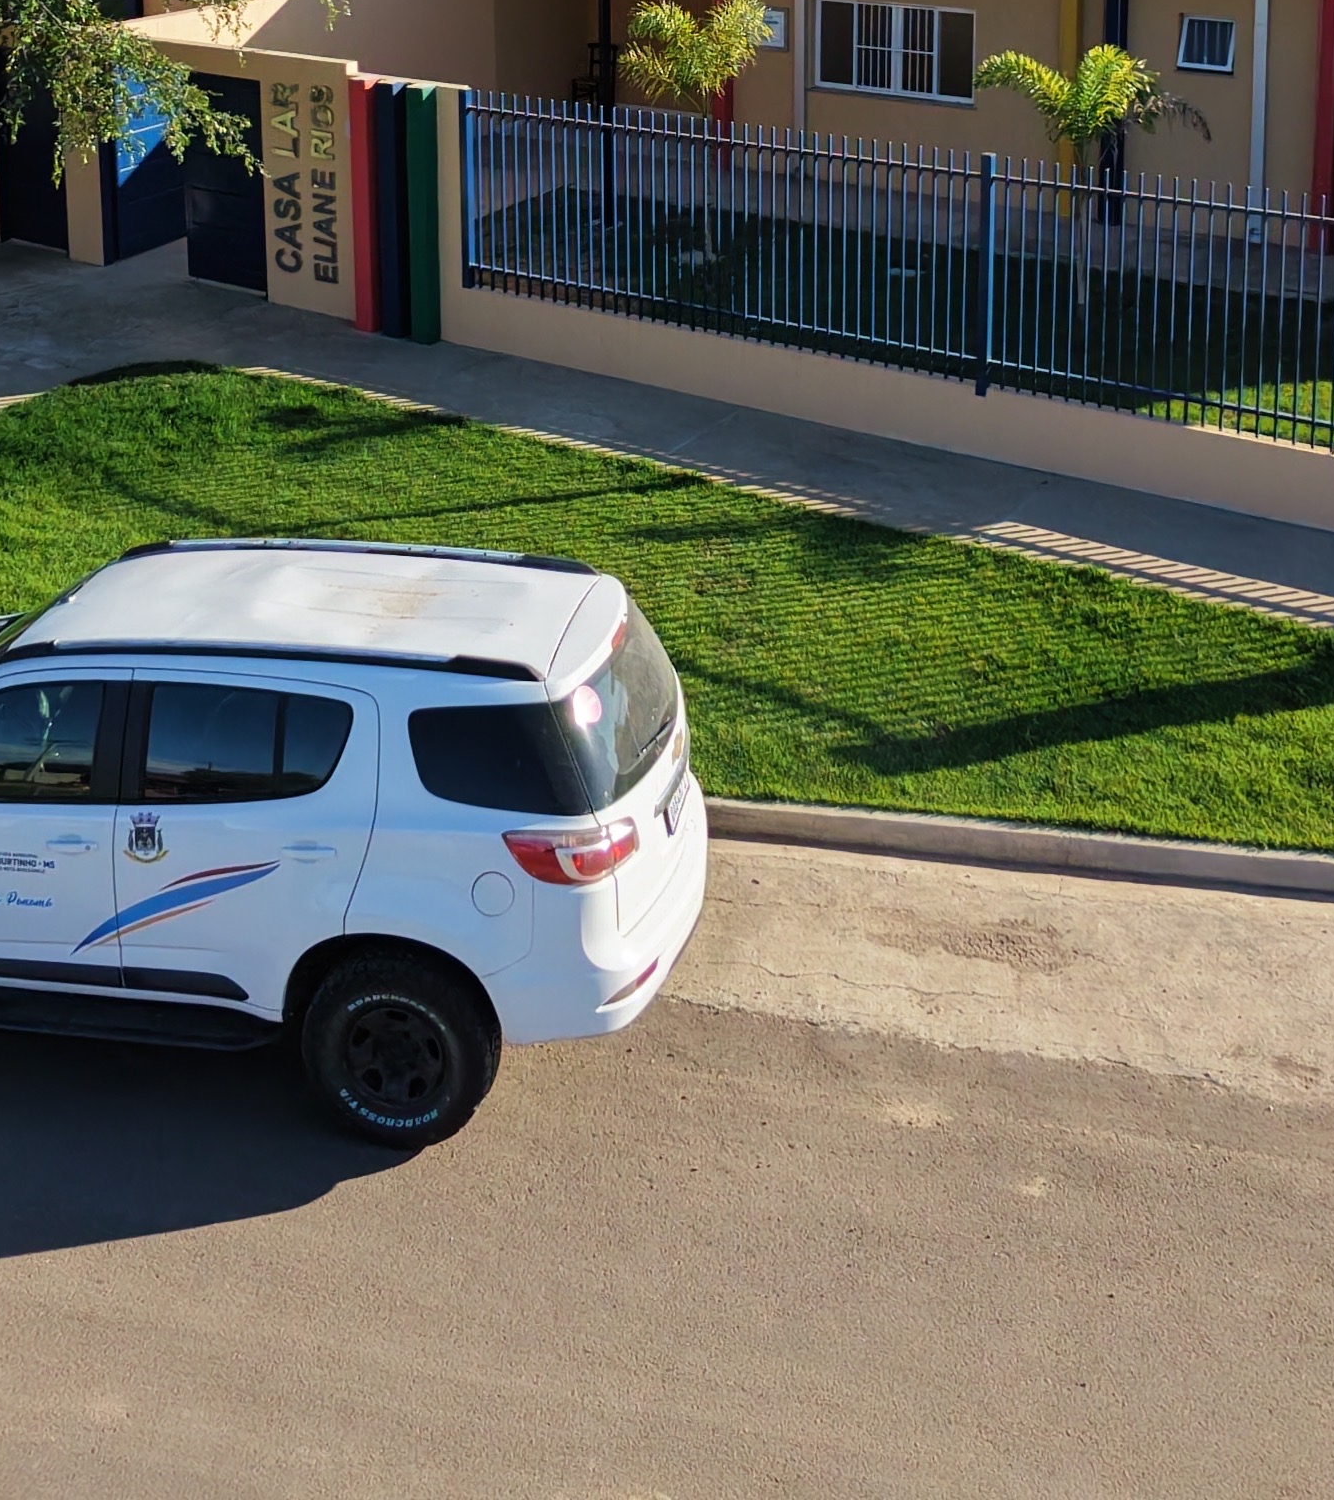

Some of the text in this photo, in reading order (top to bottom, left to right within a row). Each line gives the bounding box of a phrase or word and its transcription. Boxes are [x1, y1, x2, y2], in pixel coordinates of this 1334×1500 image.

[270, 83, 303, 273] CASA LAR
[310, 85, 339, 284] ELIANE RIOS
